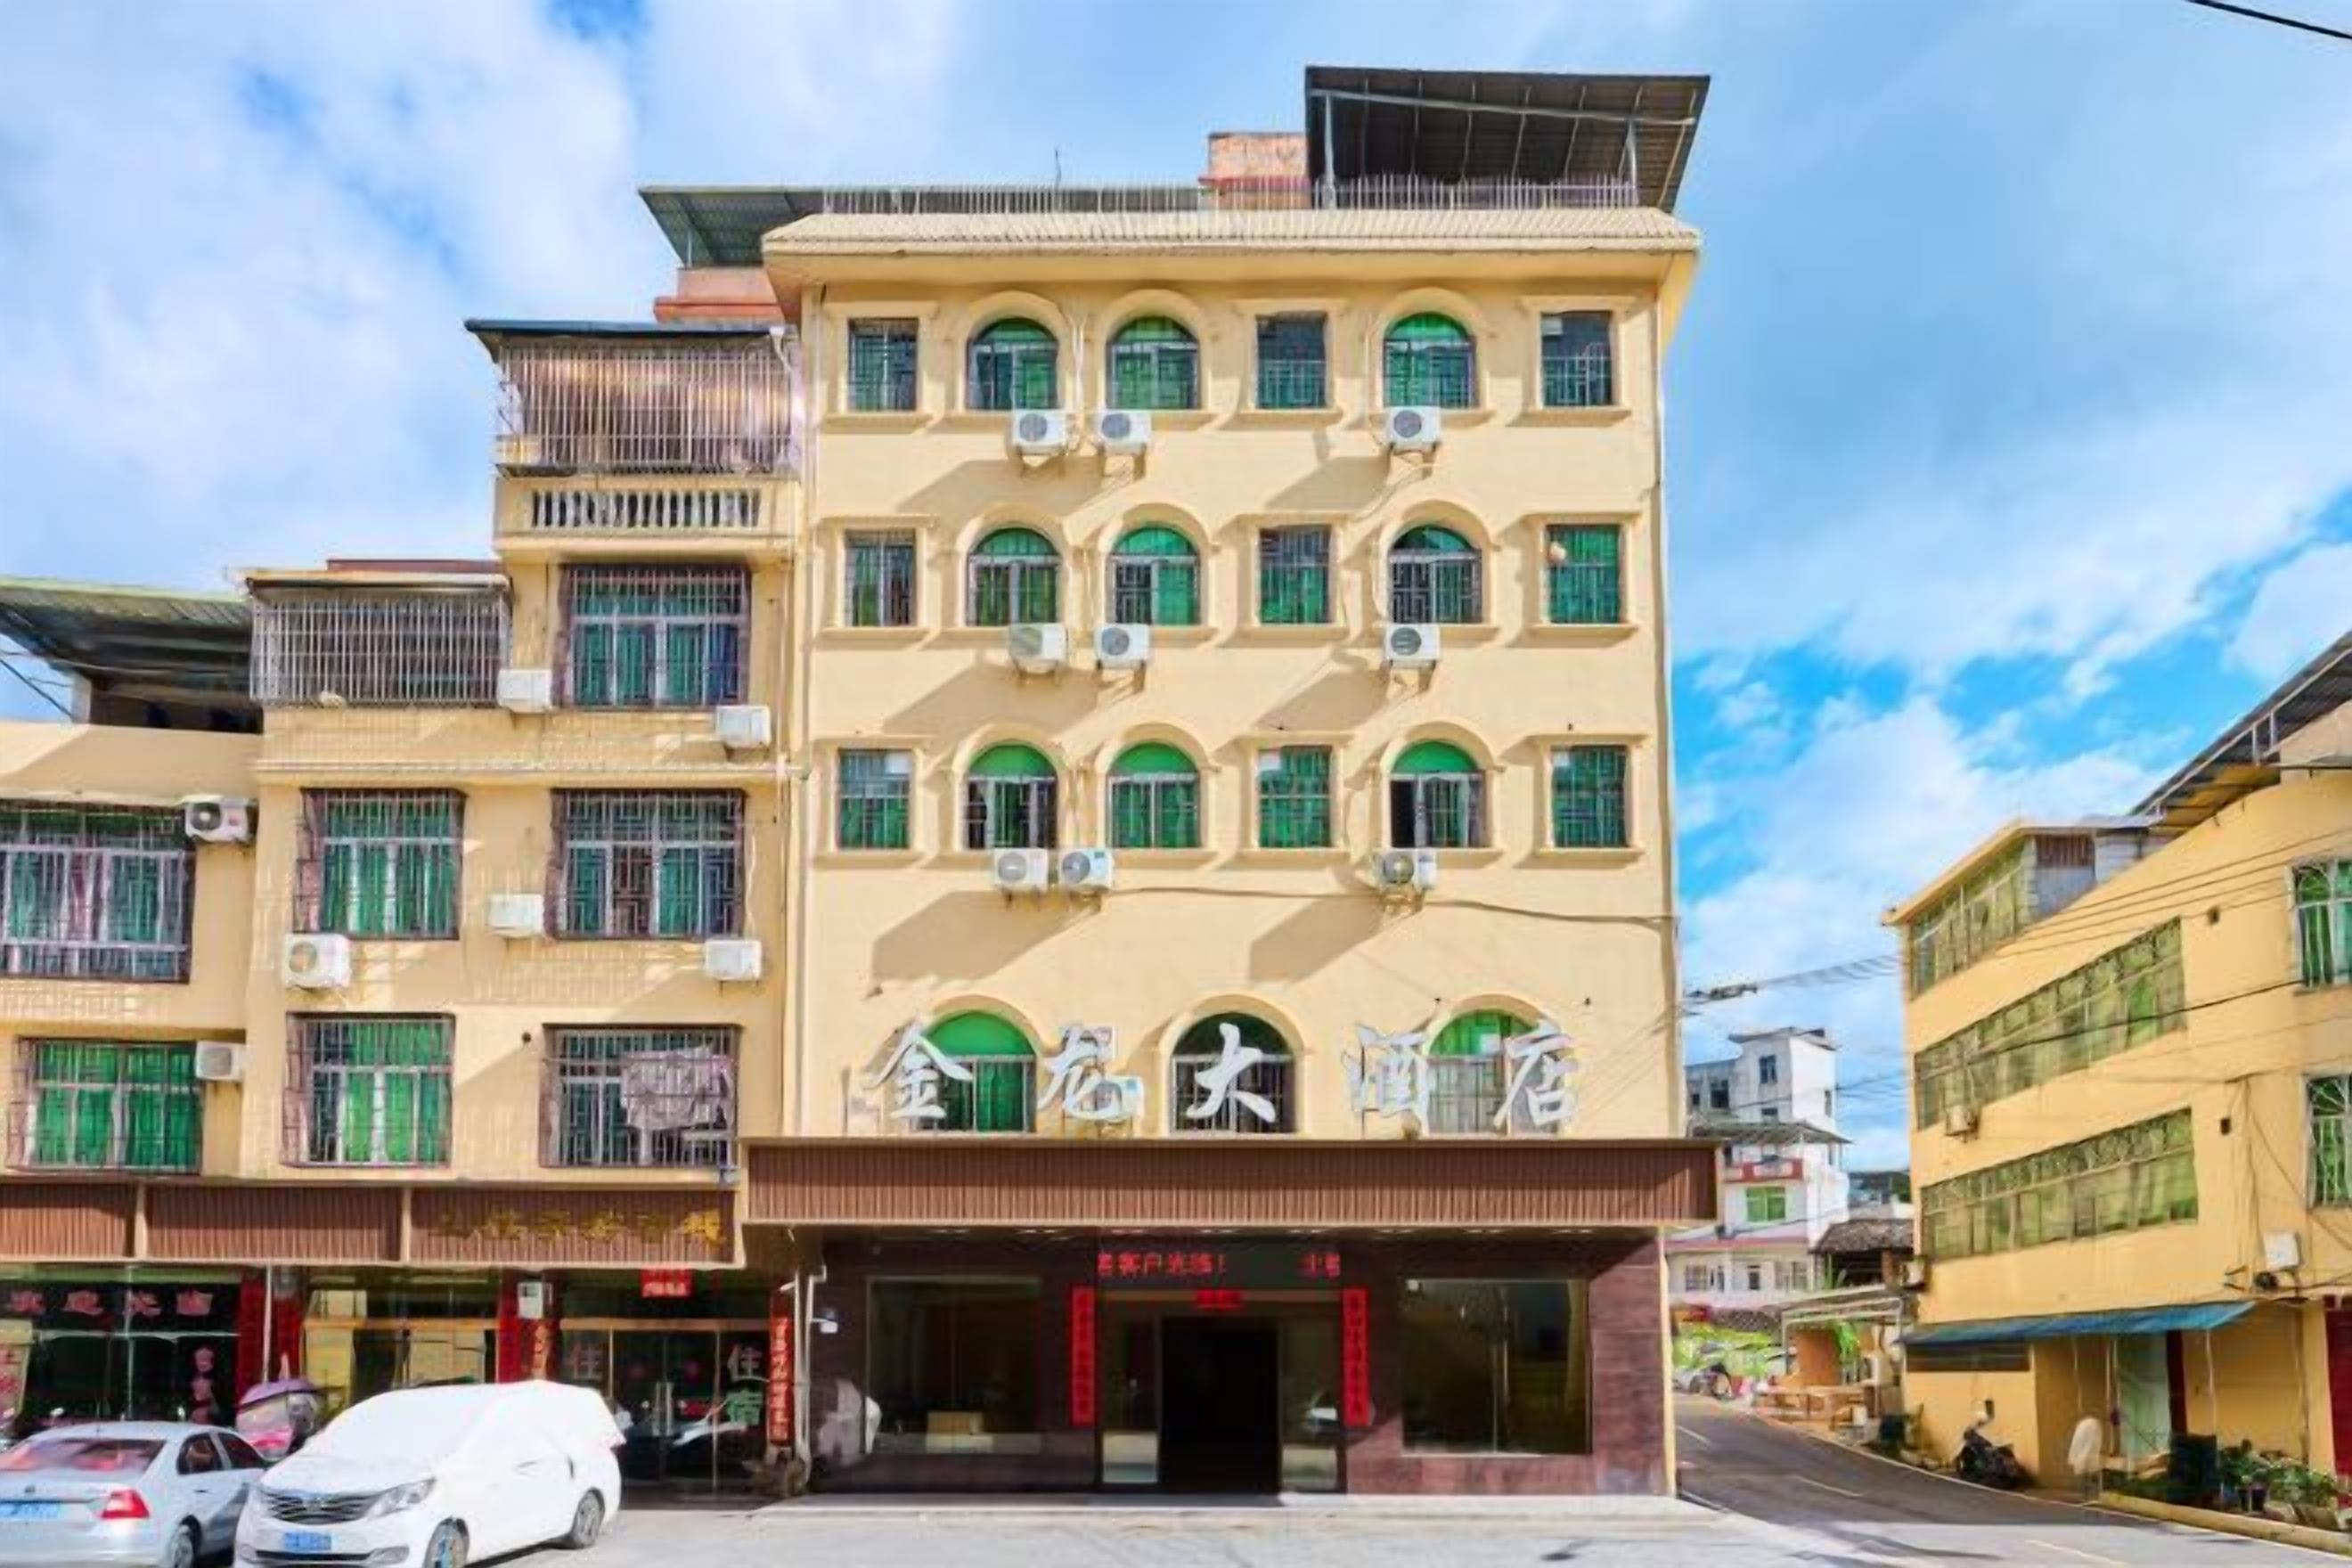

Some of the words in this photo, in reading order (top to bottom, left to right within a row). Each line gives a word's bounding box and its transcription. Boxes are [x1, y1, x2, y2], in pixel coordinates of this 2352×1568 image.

[862, 1022, 1577, 1136] 金龙大酒店
